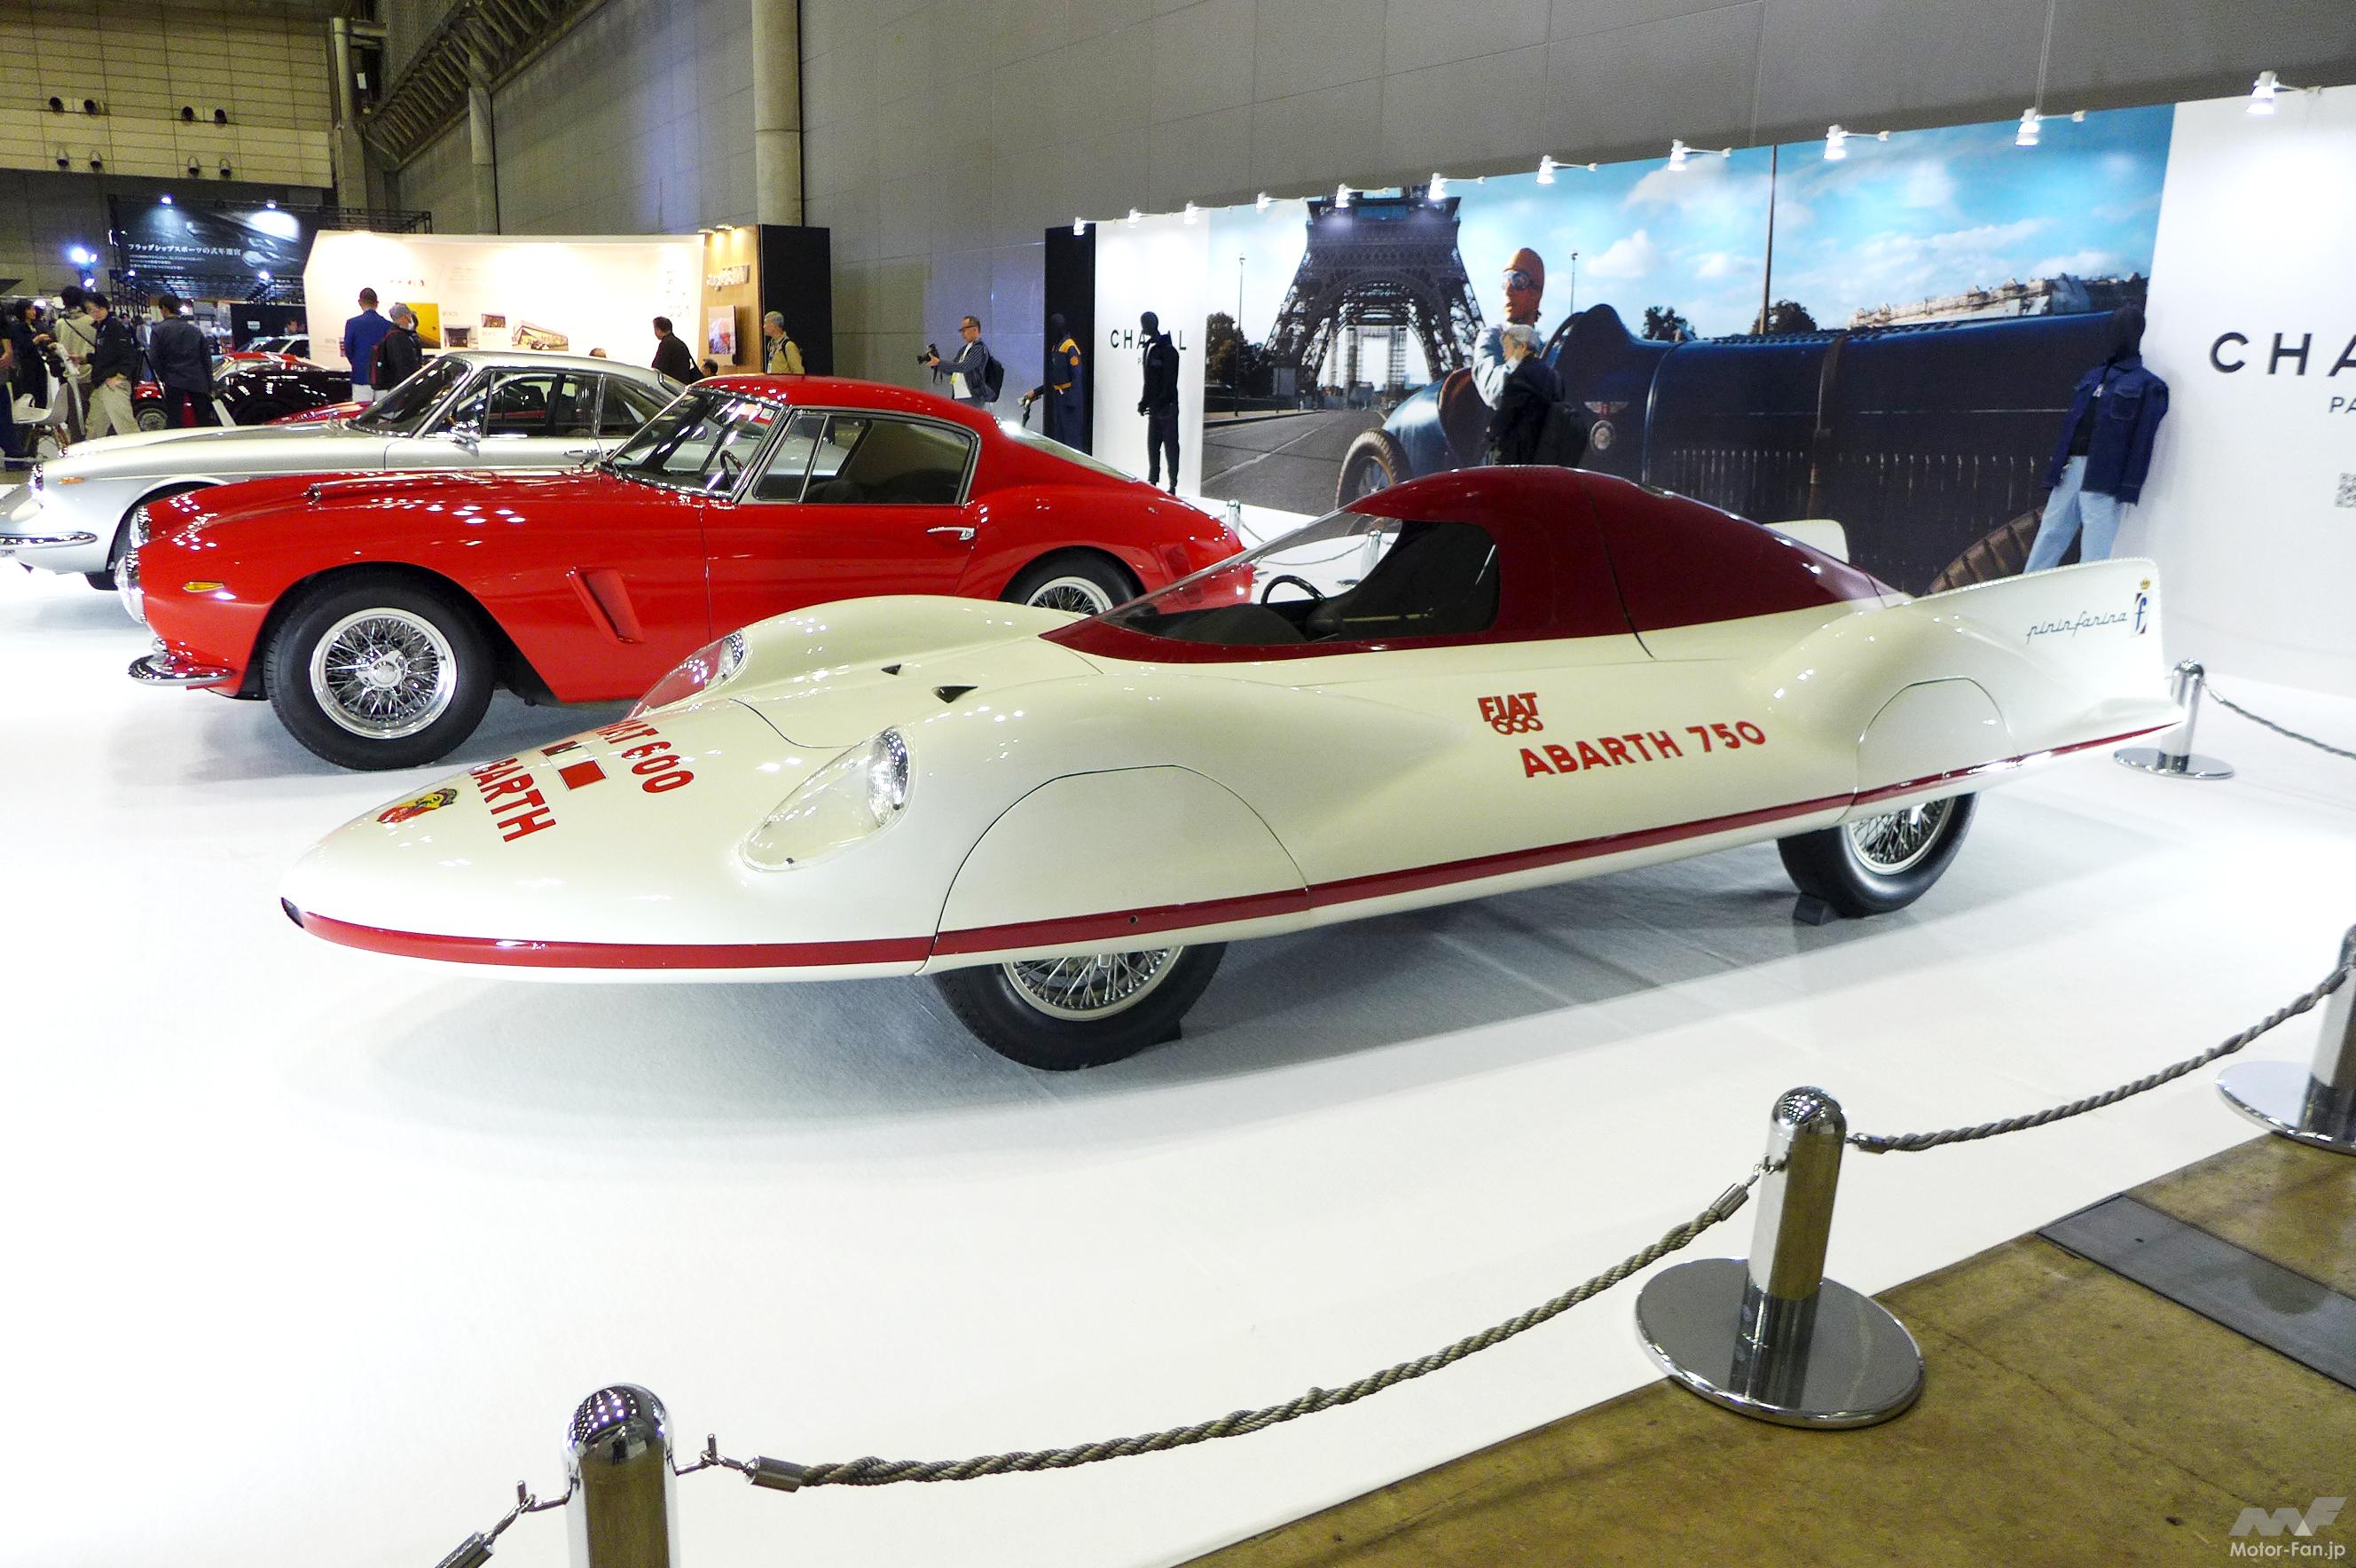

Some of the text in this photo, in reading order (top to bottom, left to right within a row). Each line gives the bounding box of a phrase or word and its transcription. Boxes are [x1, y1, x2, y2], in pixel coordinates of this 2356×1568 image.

[1110, 329, 1187, 350] CHAL
[1478, 692, 1539, 722] FIAT
[1491, 714, 1544, 735] 600
[595, 719, 695, 794] IAT 600
[1519, 720, 1767, 778] ABARTH 750
